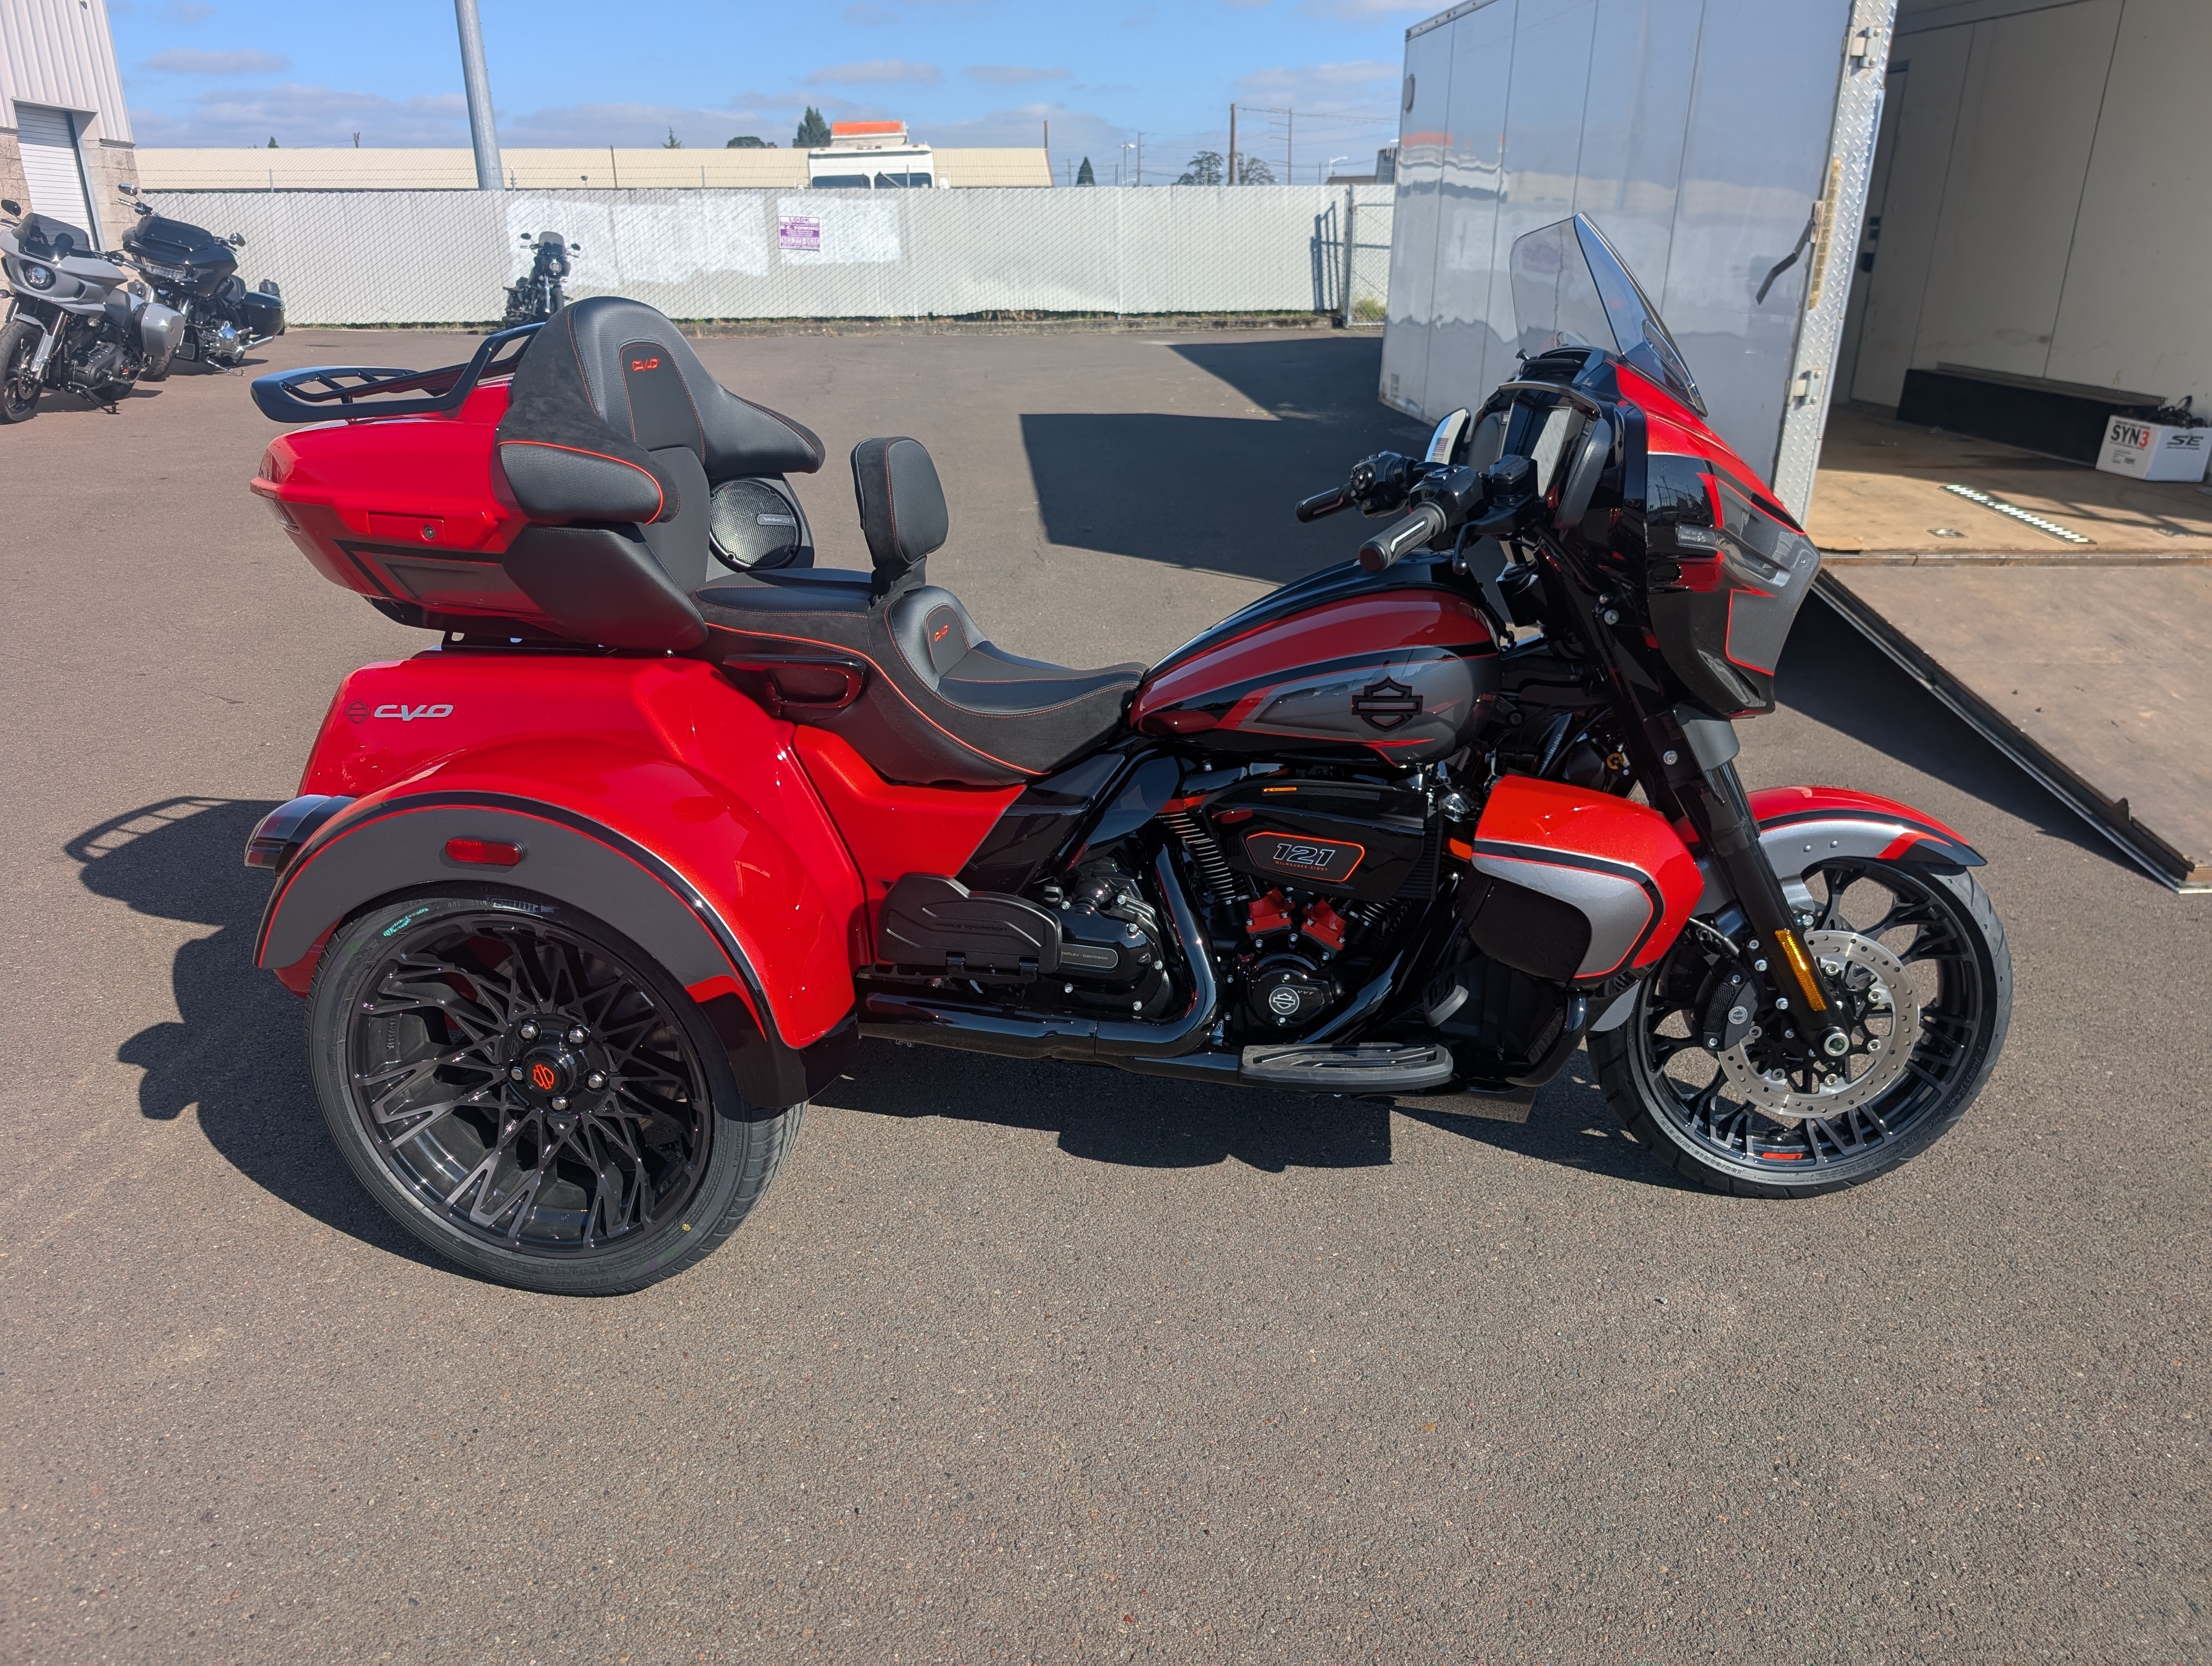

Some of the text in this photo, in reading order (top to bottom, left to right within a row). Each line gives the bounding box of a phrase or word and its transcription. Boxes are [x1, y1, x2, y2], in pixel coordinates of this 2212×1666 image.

[2111, 425, 2150, 448] SYN3
[2166, 435, 2204, 446] SE
[374, 704, 454, 721] CVO
[1272, 843, 1336, 867] 121
